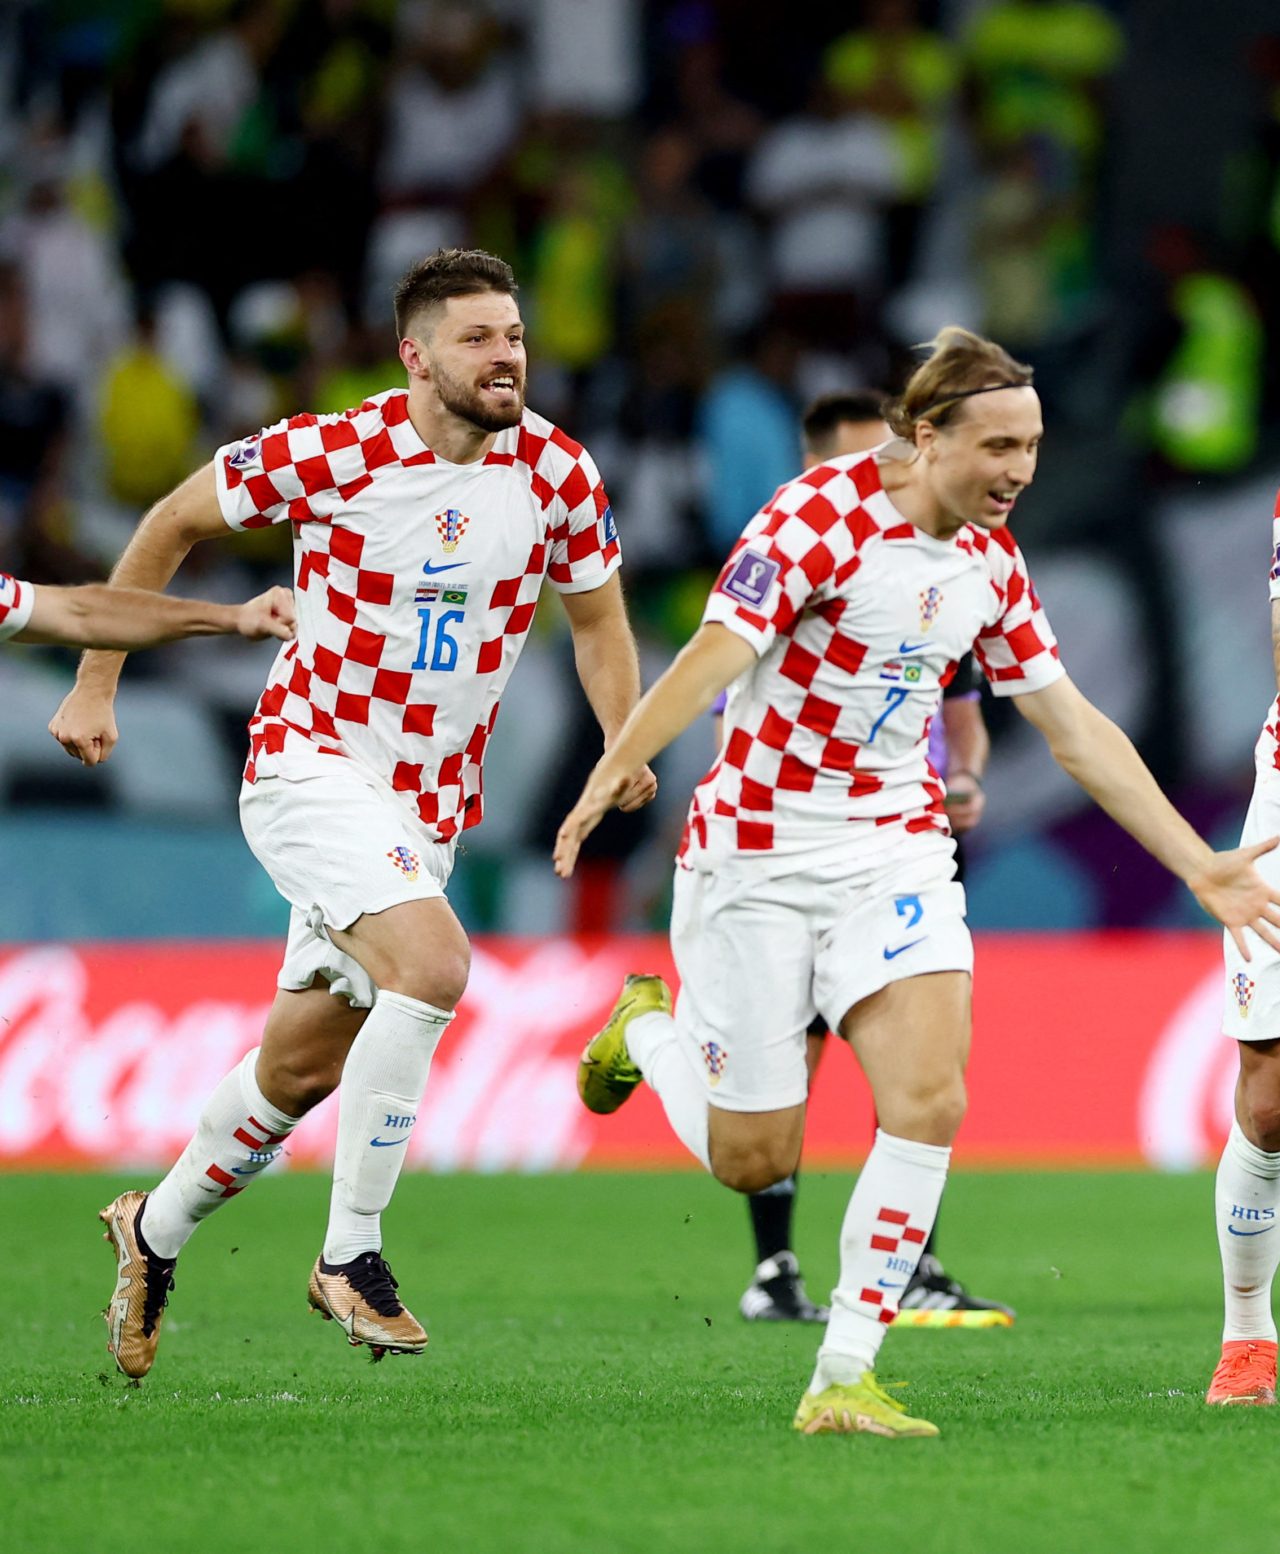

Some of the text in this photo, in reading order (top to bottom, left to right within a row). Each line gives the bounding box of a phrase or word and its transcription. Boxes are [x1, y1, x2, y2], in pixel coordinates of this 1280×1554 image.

[411, 608, 465, 672] 16
[867, 687, 910, 743] 7
[1230, 1203, 1275, 1221] HNS
